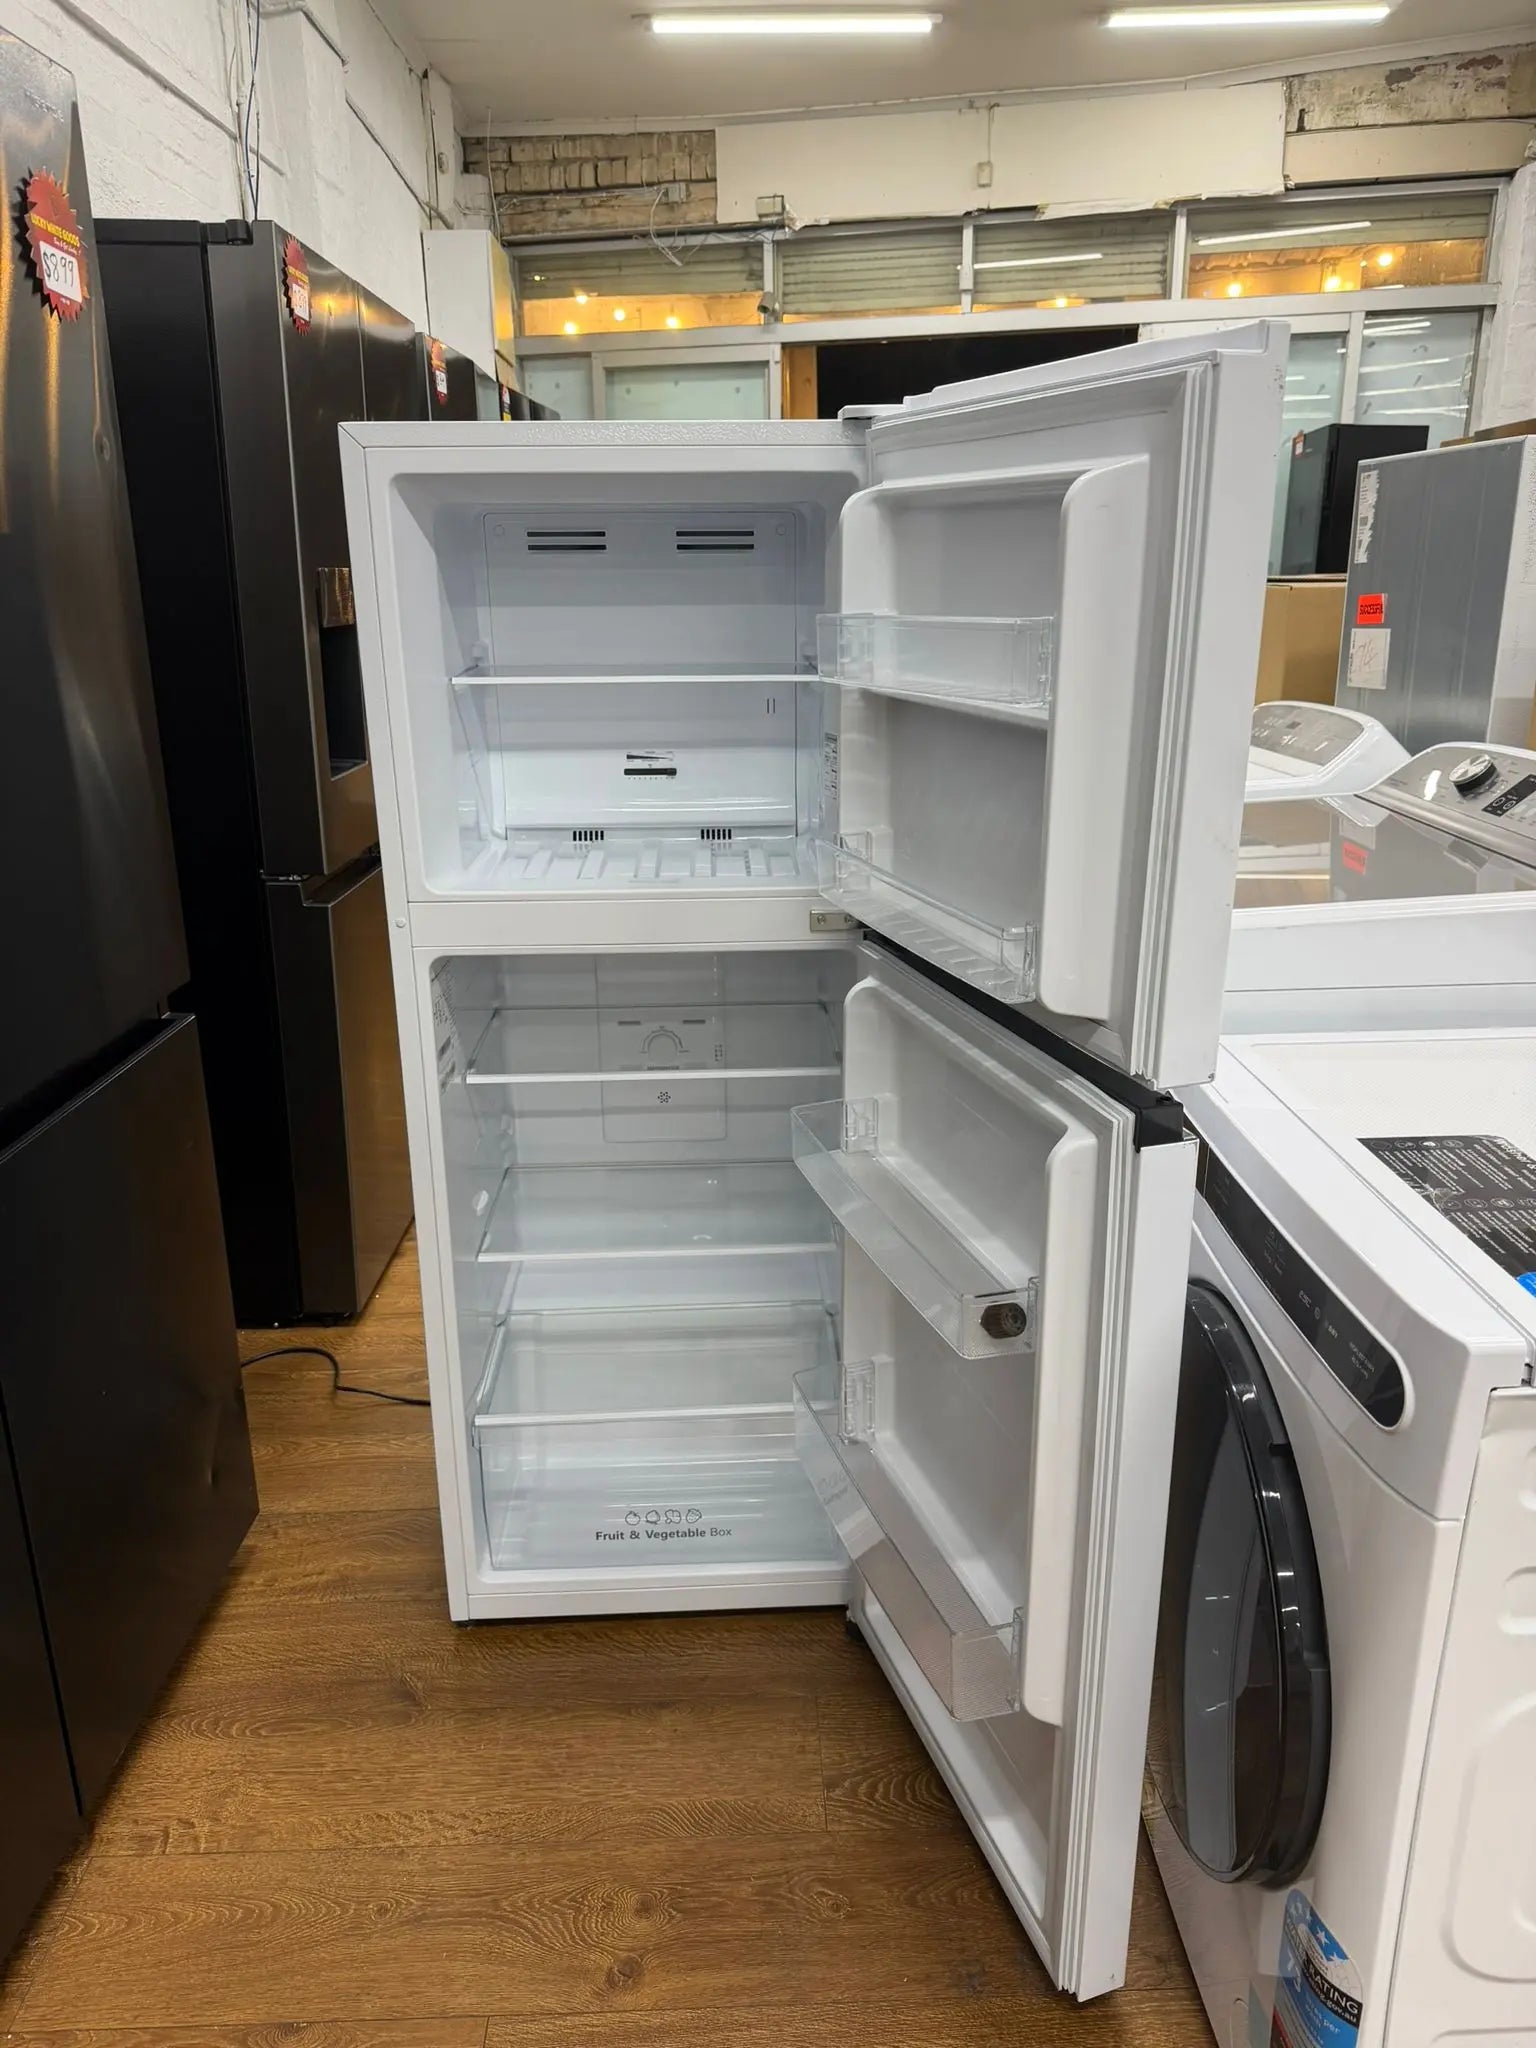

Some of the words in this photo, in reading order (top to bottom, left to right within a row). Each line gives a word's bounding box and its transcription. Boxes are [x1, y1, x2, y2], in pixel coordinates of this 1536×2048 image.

[47, 221, 63, 239] WHITE
[62, 229, 80, 248] GOODS
[42, 251, 74, 288] $899
[595, 1530, 625, 1541] Fruit
[629, 1529, 641, 1540] &
[645, 1527, 706, 1541] Vegetable
[710, 1527, 732, 1537] Box
